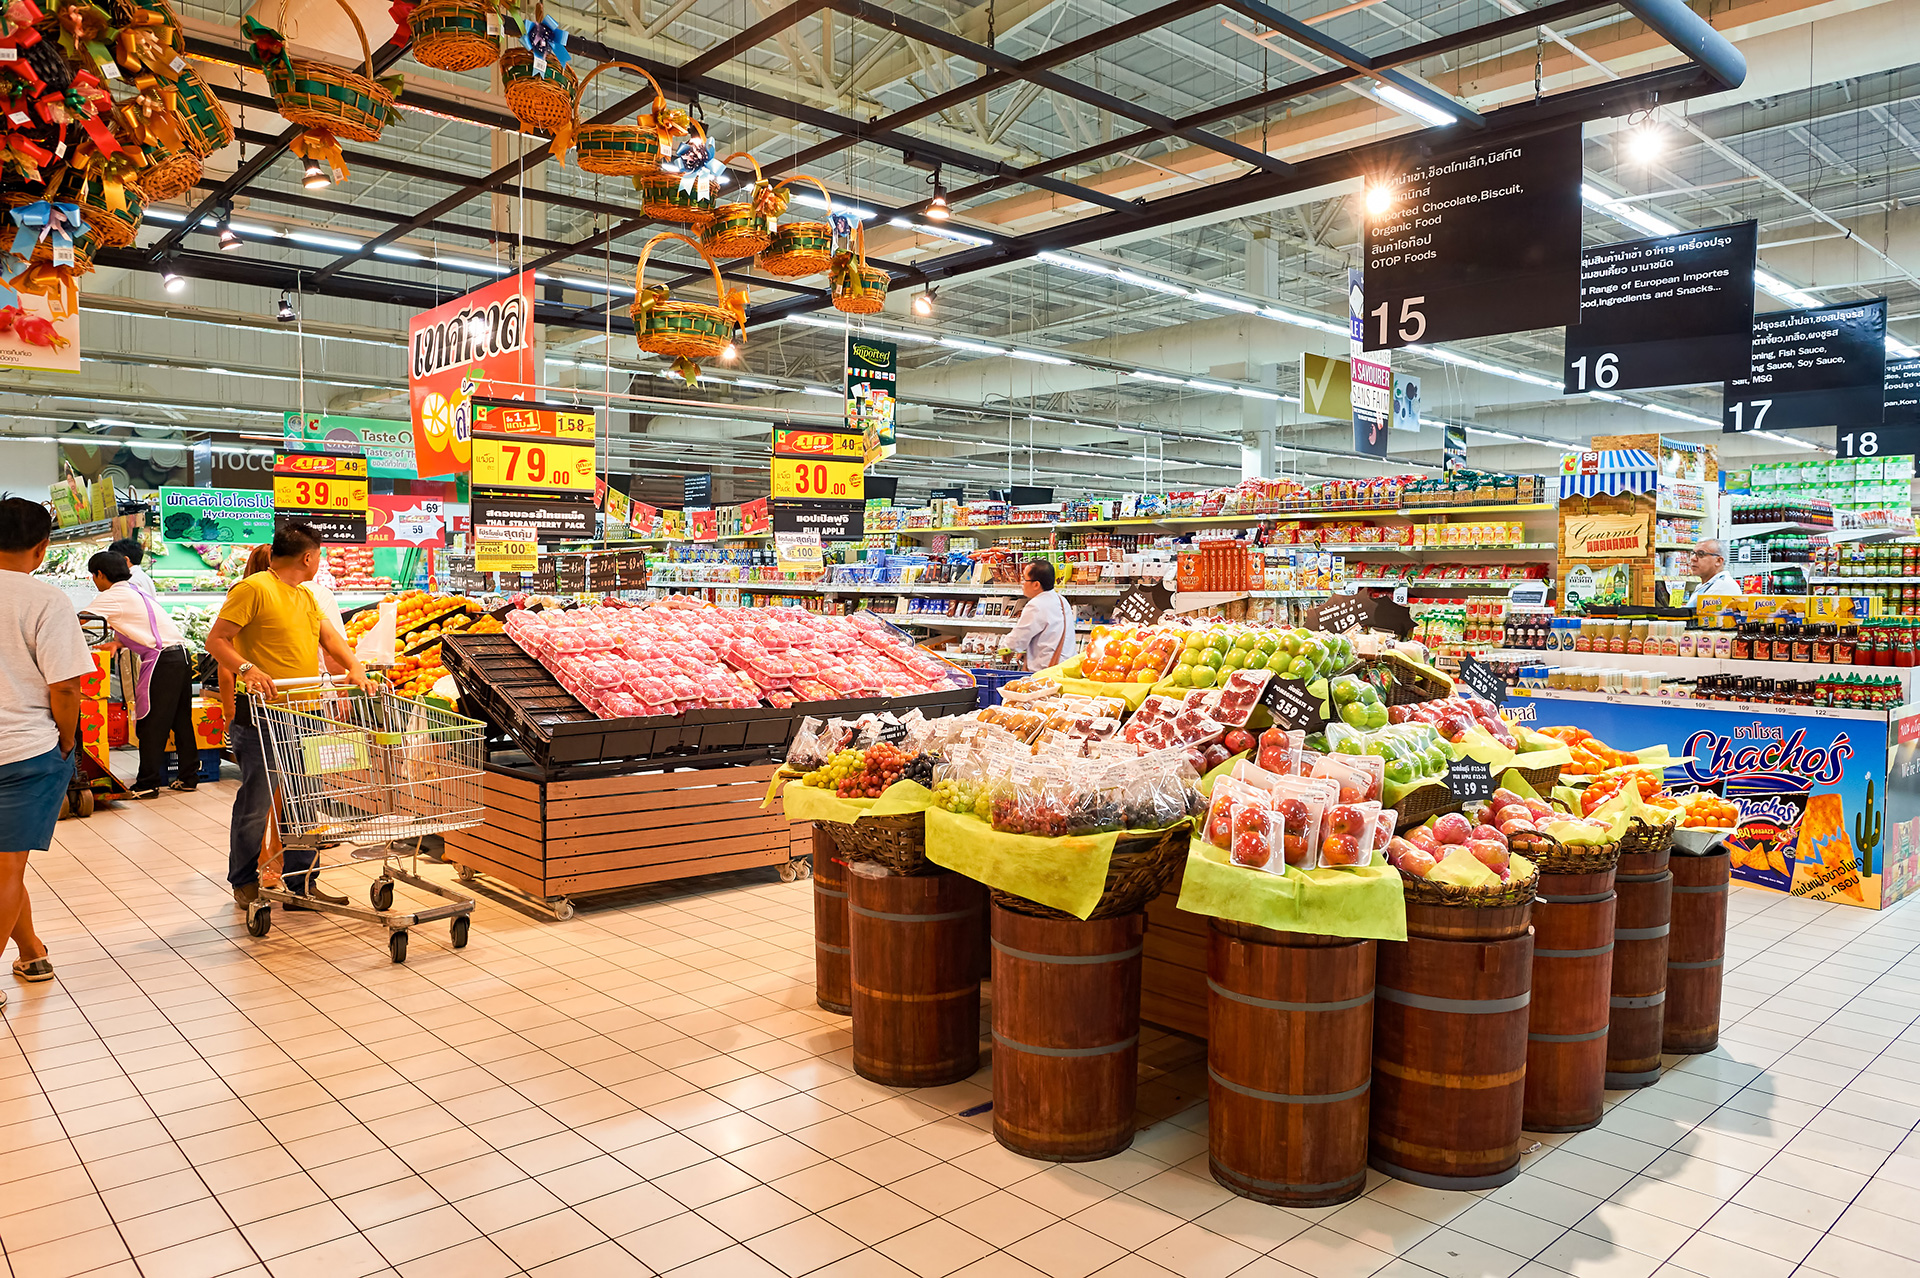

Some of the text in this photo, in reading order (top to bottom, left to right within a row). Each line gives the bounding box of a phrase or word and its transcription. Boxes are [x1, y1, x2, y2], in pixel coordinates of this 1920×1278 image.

[1372, 215, 1442, 237] Organic Food
[1371, 250, 1437, 269] OTOP Foods
[1589, 284, 1619, 296] Range
[1621, 281, 1632, 290] of
[1634, 276, 1680, 289] European
[1683, 269, 1730, 282] Importes
[1654, 290, 1673, 299] and
[1371, 296, 1427, 345] 15
[1778, 349, 1796, 358] Fish
[1798, 347, 1827, 356] Sauce,
[1571, 352, 1619, 390] 16
[1766, 361, 1795, 371] Sauce,
[1797, 358, 1813, 368] Soy
[1816, 355, 1846, 366] Sauce,
[1357, 362, 1390, 387] SAVOURER
[1752, 375, 1773, 383] MSG
[1352, 384, 1371, 407] SANS
[1728, 399, 1773, 431] 17
[558, 417, 584, 432] 158
[361, 429, 396, 443] Taste
[841, 438, 854, 450] 40
[1841, 431, 1879, 456] 18
[365, 447, 394, 457] Tastes
[395, 447, 405, 457] of
[344, 462, 358, 471] 49
[502, 445, 546, 482] 79
[795, 463, 828, 494] 30
[296, 481, 329, 506] 39
[202, 510, 271, 520] Hydroponics
[426, 503, 438, 513] 69
[412, 525, 423, 534] 59
[508, 520, 562, 529] STRAWBERRY
[565, 521, 586, 529] PACK
[822, 527, 845, 535] APPLE
[1569, 521, 1642, 549] Gourmet
[504, 543, 526, 554] 100
[797, 548, 813, 557] 100
[1333, 613, 1356, 632] 159
[1472, 676, 1488, 693] 129
[1276, 698, 1299, 718] 359
[1734, 721, 1783, 740] ชาโชส
[1464, 782, 1477, 795] 59
